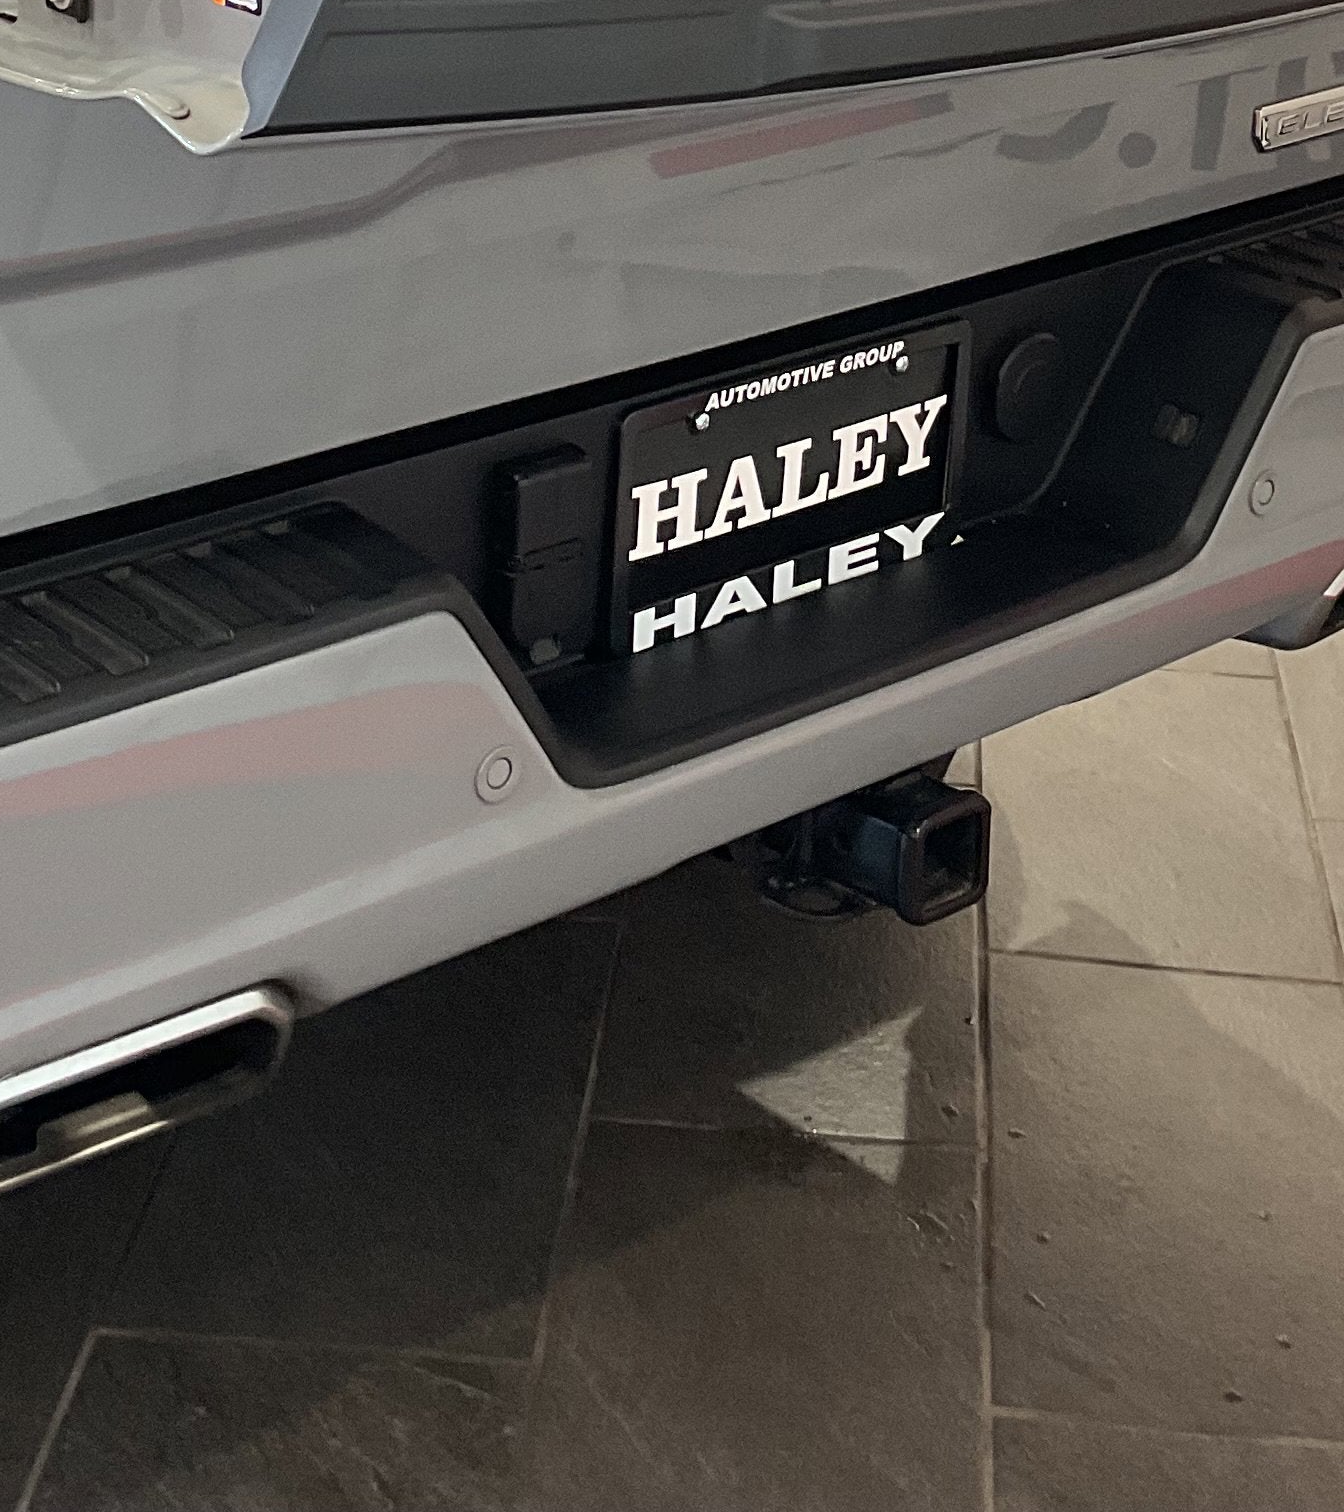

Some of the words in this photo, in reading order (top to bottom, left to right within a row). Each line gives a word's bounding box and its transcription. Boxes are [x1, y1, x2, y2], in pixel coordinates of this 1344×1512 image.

[705, 359, 835, 412] AUTOMOTIVE
[839, 340, 906, 374] GROUP
[628, 394, 948, 562] HALEY
[632, 511, 946, 654] HALEY
